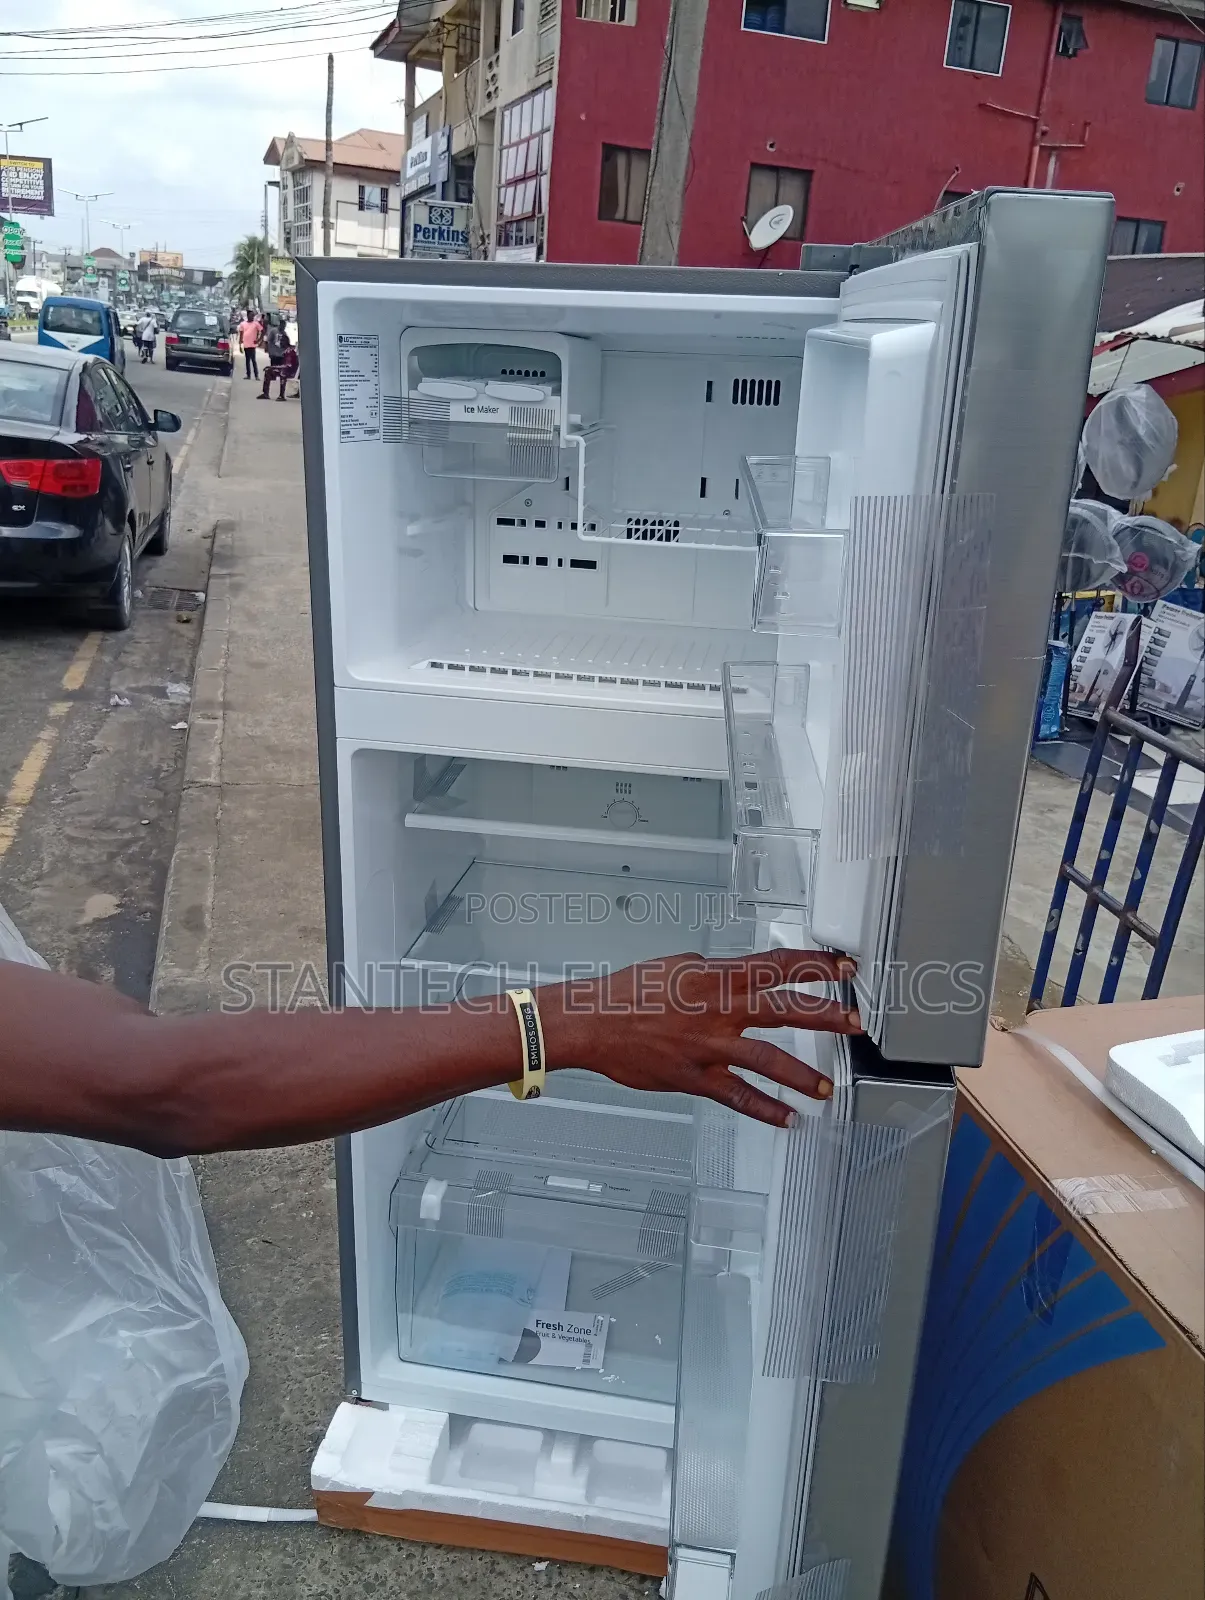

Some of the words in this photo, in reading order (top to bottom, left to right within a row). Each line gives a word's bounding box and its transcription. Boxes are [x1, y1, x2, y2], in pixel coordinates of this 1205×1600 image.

[19, 172, 44, 180] ENJOY
[413, 223, 469, 243] Perkins
[464, 404, 475, 414] Ice
[477, 405, 500, 414] Maker
[523, 1007, 539, 1066] SMHOS.ORG
[535, 1318, 564, 1332] Fresh
[567, 1322, 592, 1336] Zone
[535, 1330, 550, 1338] Fruit
[557, 1333, 592, 1344] Vegetables
